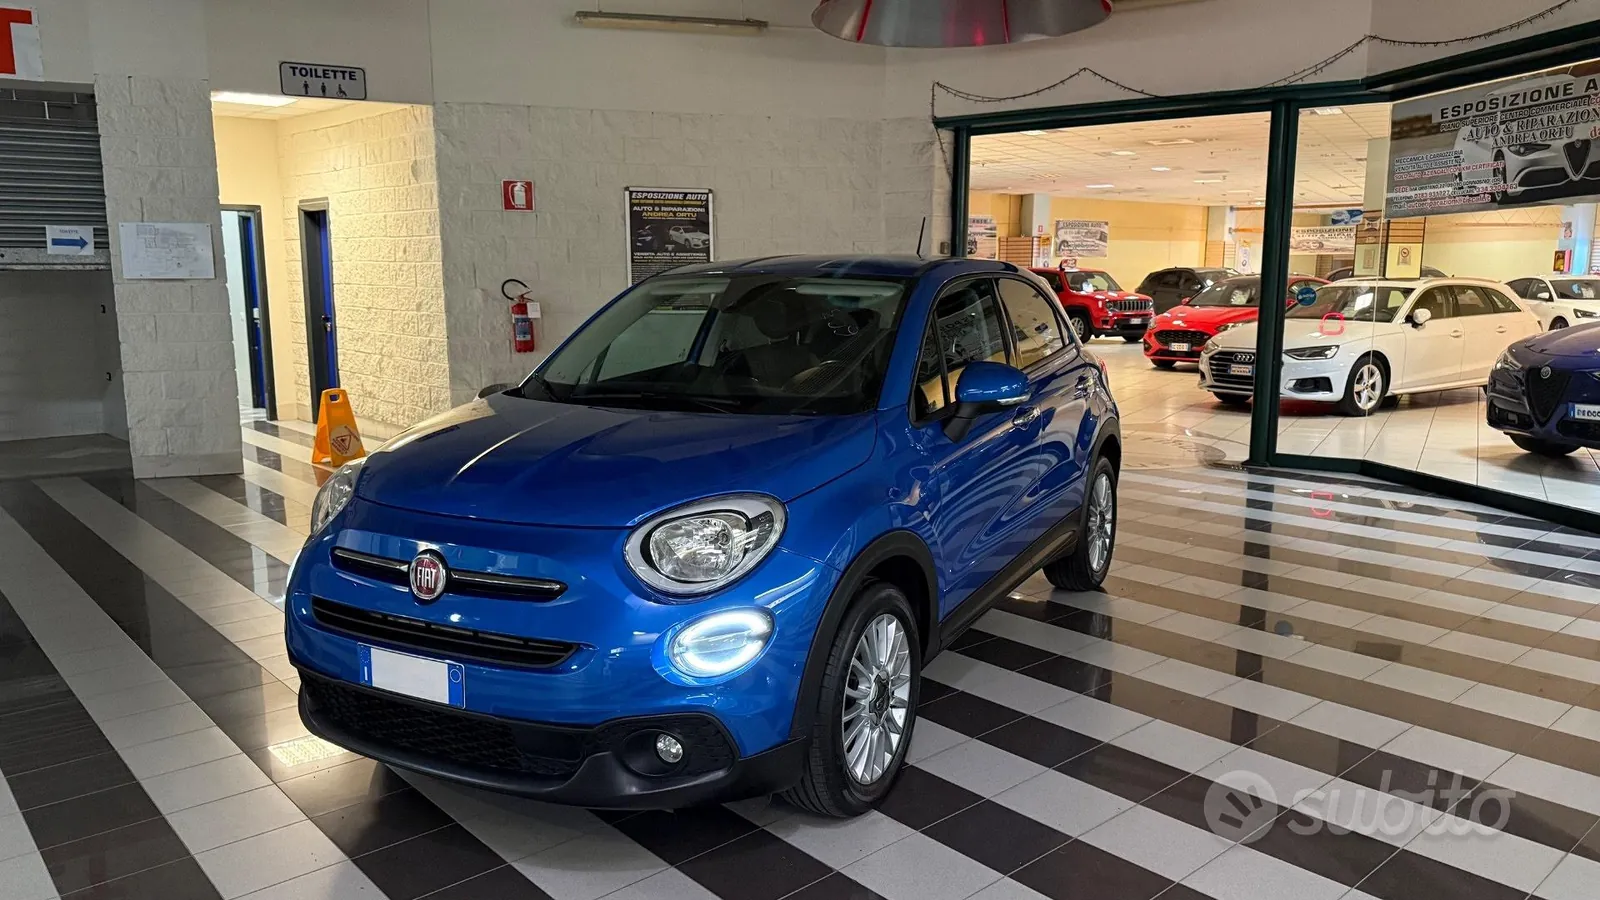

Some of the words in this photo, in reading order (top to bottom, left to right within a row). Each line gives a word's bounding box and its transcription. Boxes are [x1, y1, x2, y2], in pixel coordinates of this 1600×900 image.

[289, 66, 357, 81] TOILETTE
[1440, 82, 1574, 120] ESPOSIZIONE
[1440, 122, 1461, 132] PIANO
[1462, 114, 1499, 127] SUPERIORE
[1500, 107, 1529, 121] CENTRO
[1530, 96, 1589, 115] COMMERCIALE
[1466, 122, 1500, 141] AUTO
[1503, 121, 1515, 135] &
[1492, 130, 1537, 149] ANDREA
[1539, 124, 1575, 141] ORTU
[1395, 154, 1425, 164] MECCANICA
[632, 192, 684, 200] ESPOSIZIONE
[417, 568, 437, 589] FIAT
